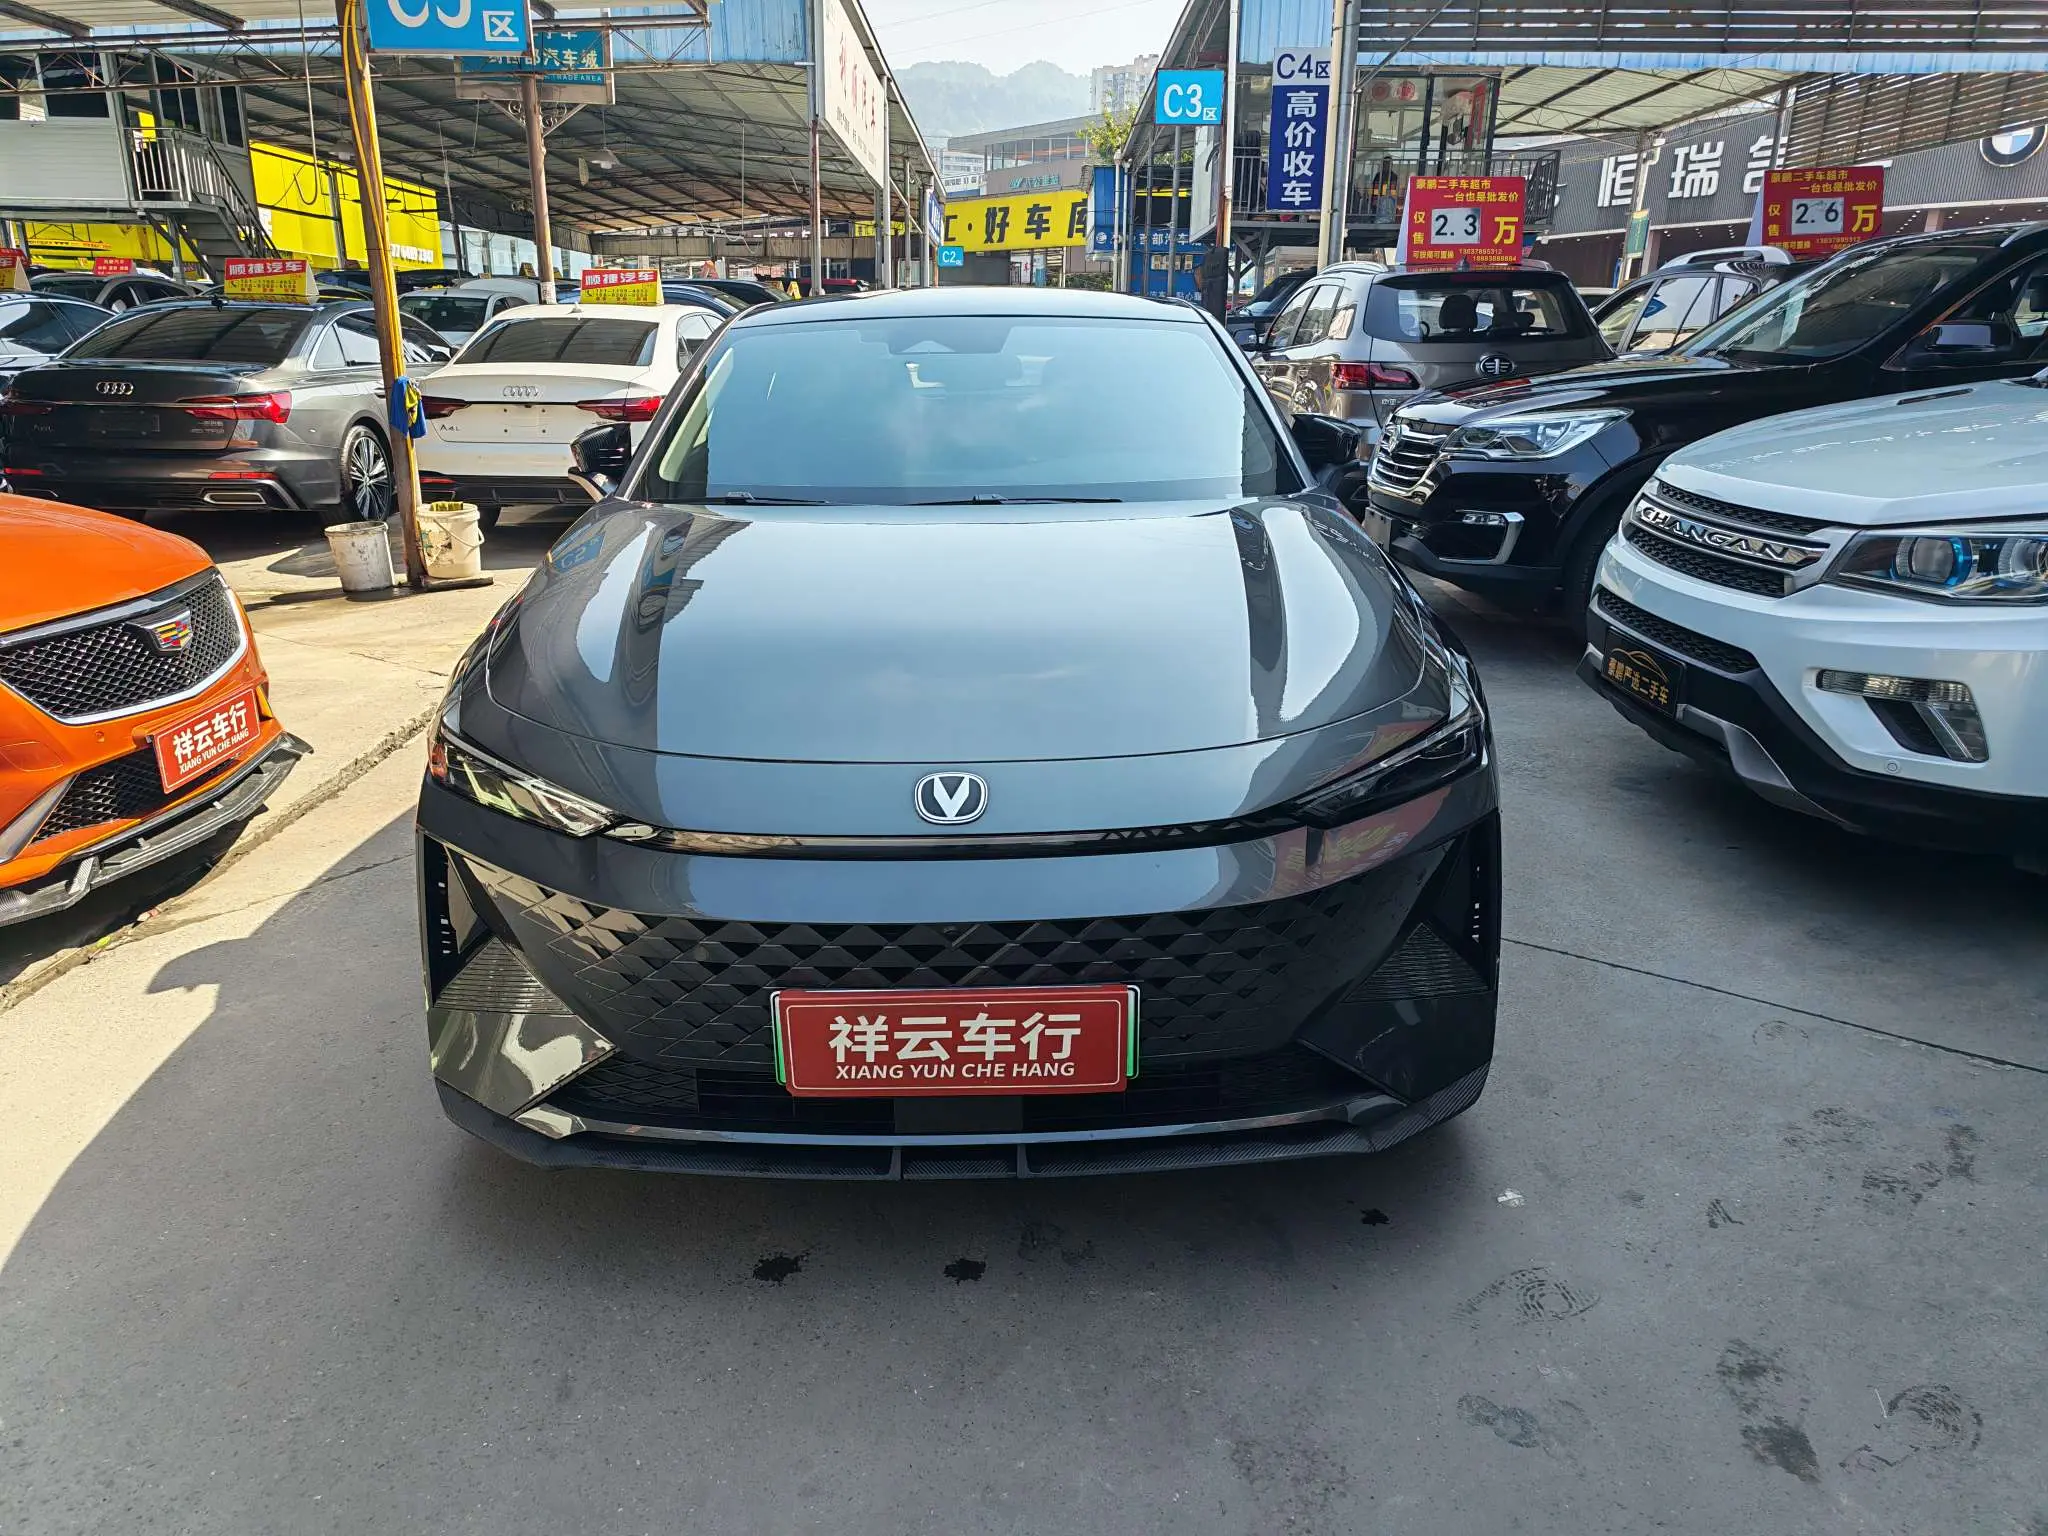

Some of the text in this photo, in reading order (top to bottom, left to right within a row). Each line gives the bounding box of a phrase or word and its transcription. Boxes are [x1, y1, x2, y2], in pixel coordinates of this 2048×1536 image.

[1277, 53, 1331, 80] C4区
[1163, 83, 1218, 121] C3区
[1280, 90, 1319, 206] 高价收车
[1443, 191, 1519, 202] 一台也是批发价
[1799, 181, 1878, 193] 一台也是批发价
[1434, 214, 1477, 237] 2.3
[1794, 202, 1839, 224] 2.6
[1851, 204, 1878, 233] 万
[1493, 216, 1519, 245] 万
[1640, 506, 1790, 561] CHANGAN
[172, 700, 247, 764] 祥云车行
[180, 728, 249, 775] XIANG YUN CHE HANG
[828, 1012, 1081, 1063] 祥云车行
[835, 1062, 1075, 1080] XIANG YUN CHE HANG
